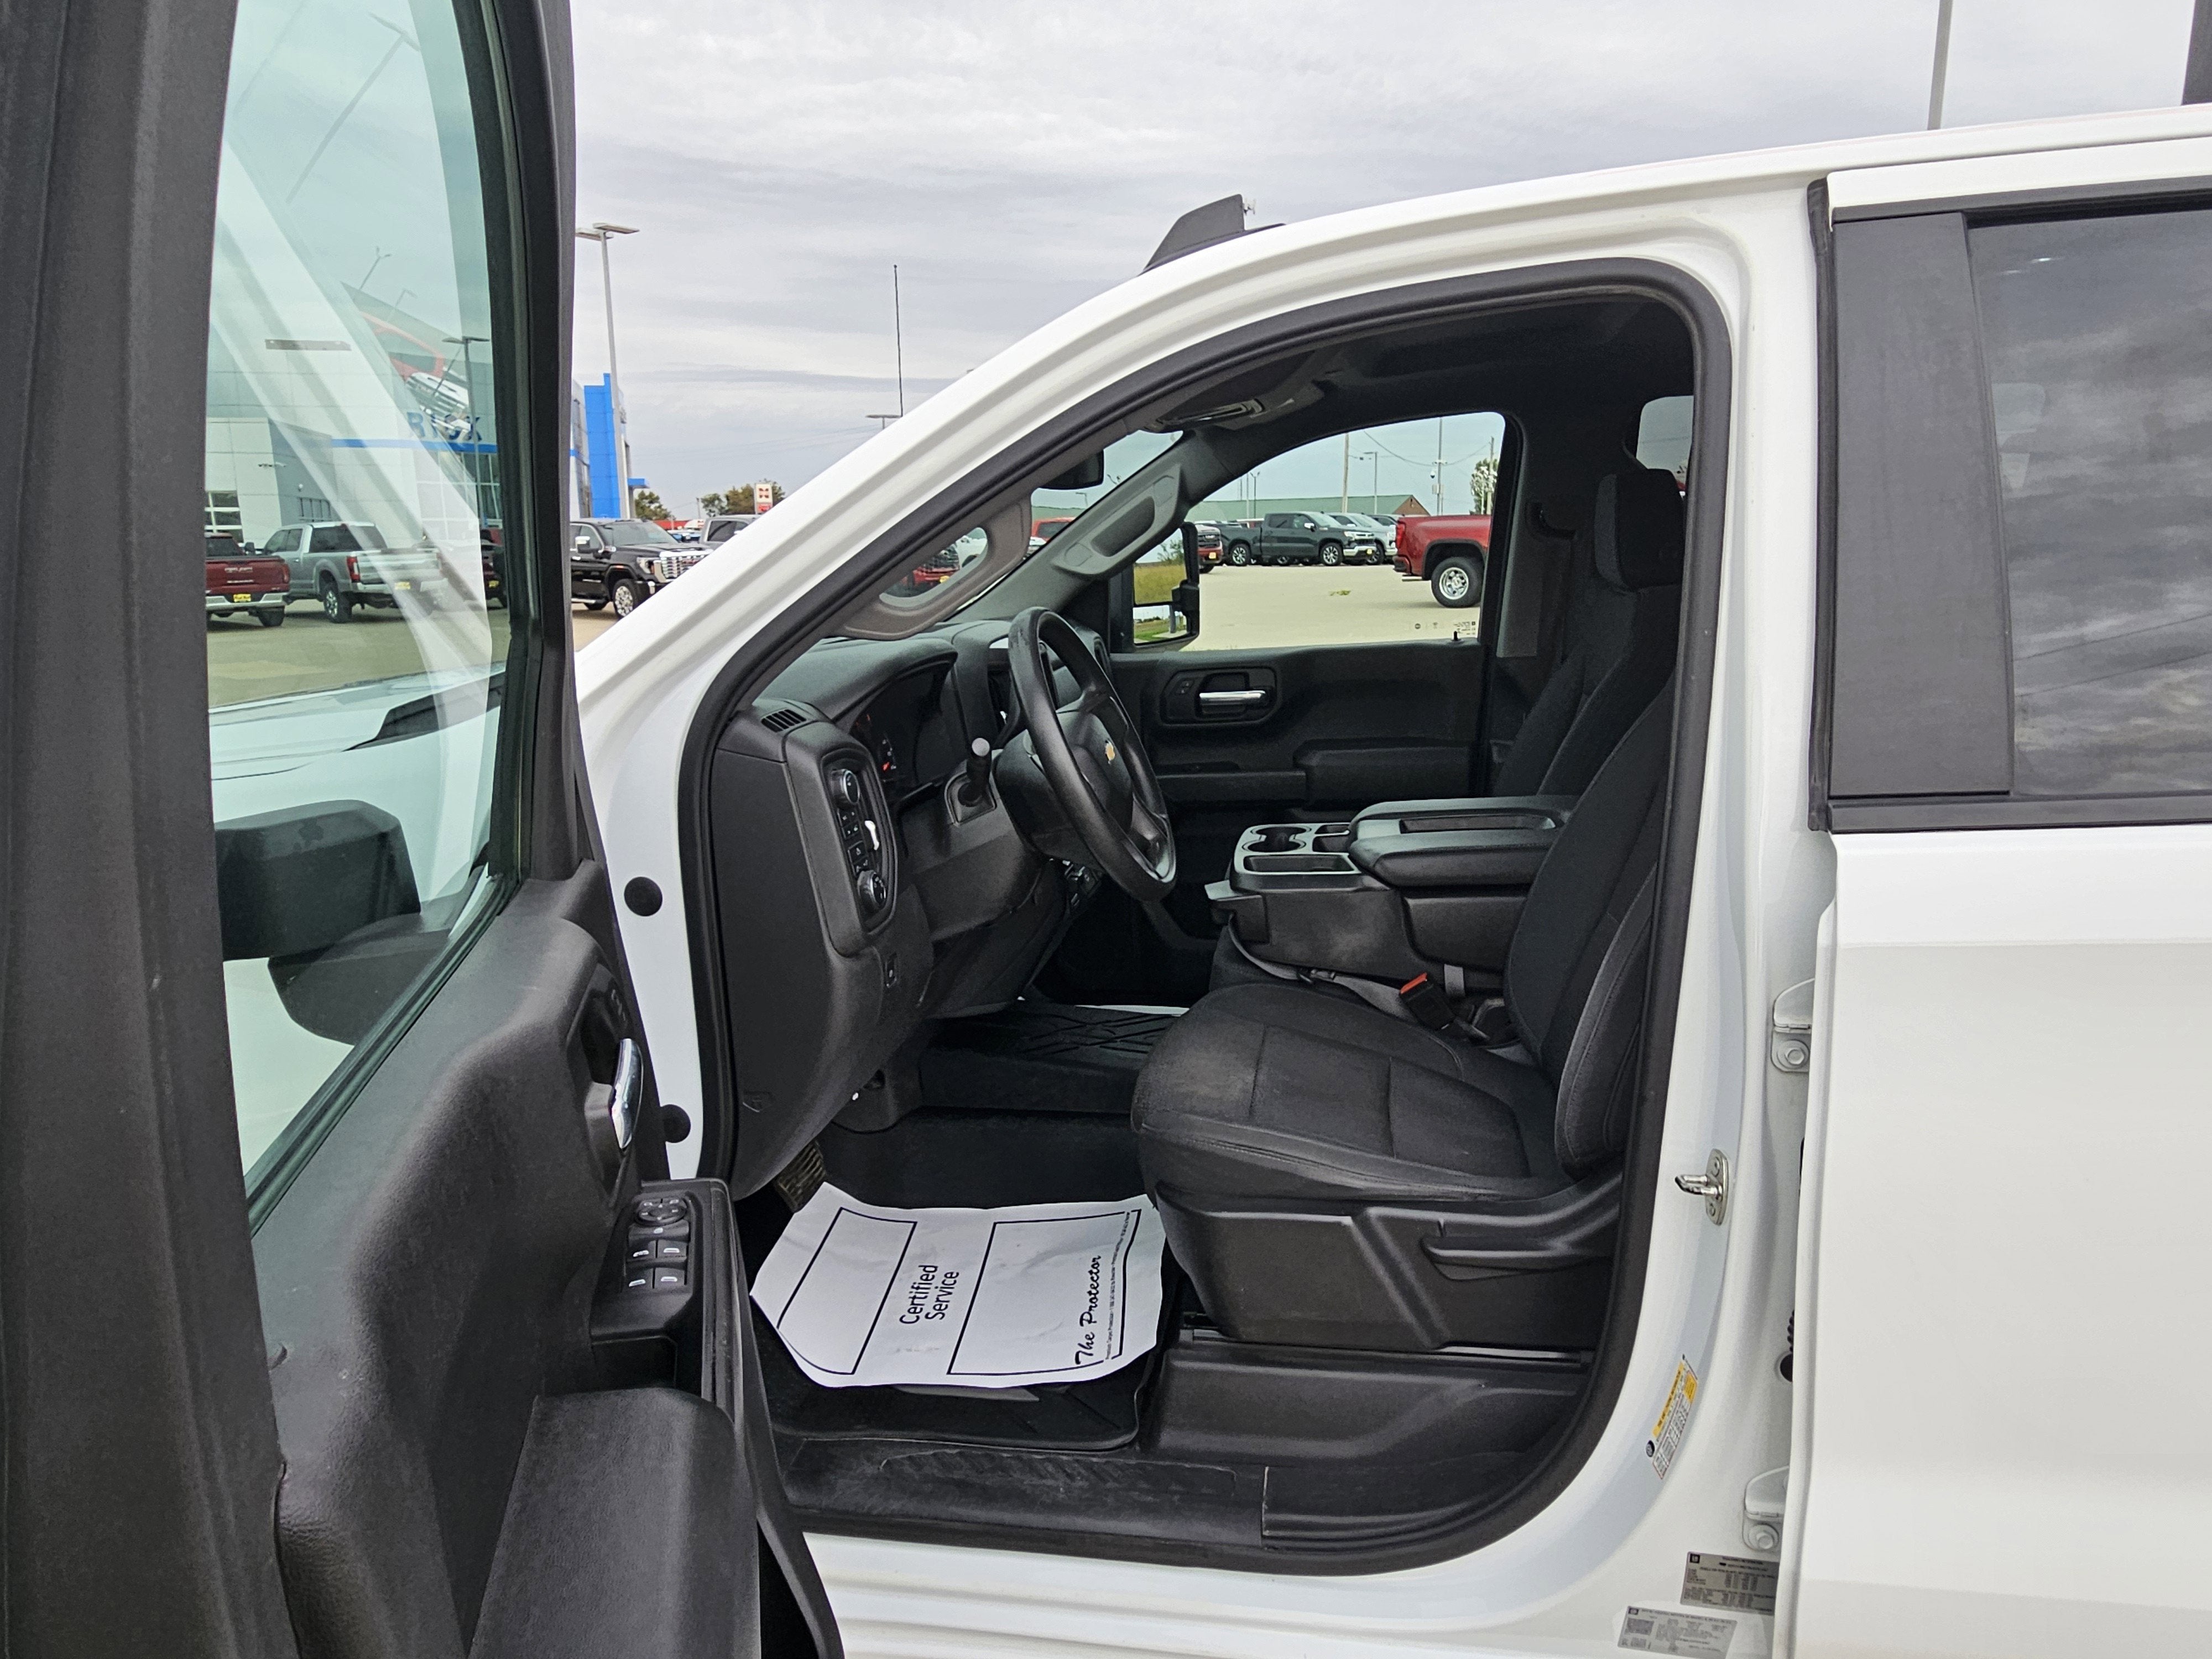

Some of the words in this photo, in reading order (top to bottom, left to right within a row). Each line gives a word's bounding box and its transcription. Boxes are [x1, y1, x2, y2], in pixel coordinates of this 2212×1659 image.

[899, 1265, 938, 1324] Certified
[925, 1271, 959, 1320] Service
[1079, 1255, 1102, 1327] Protector
[1074, 1332, 1095, 1365] The
